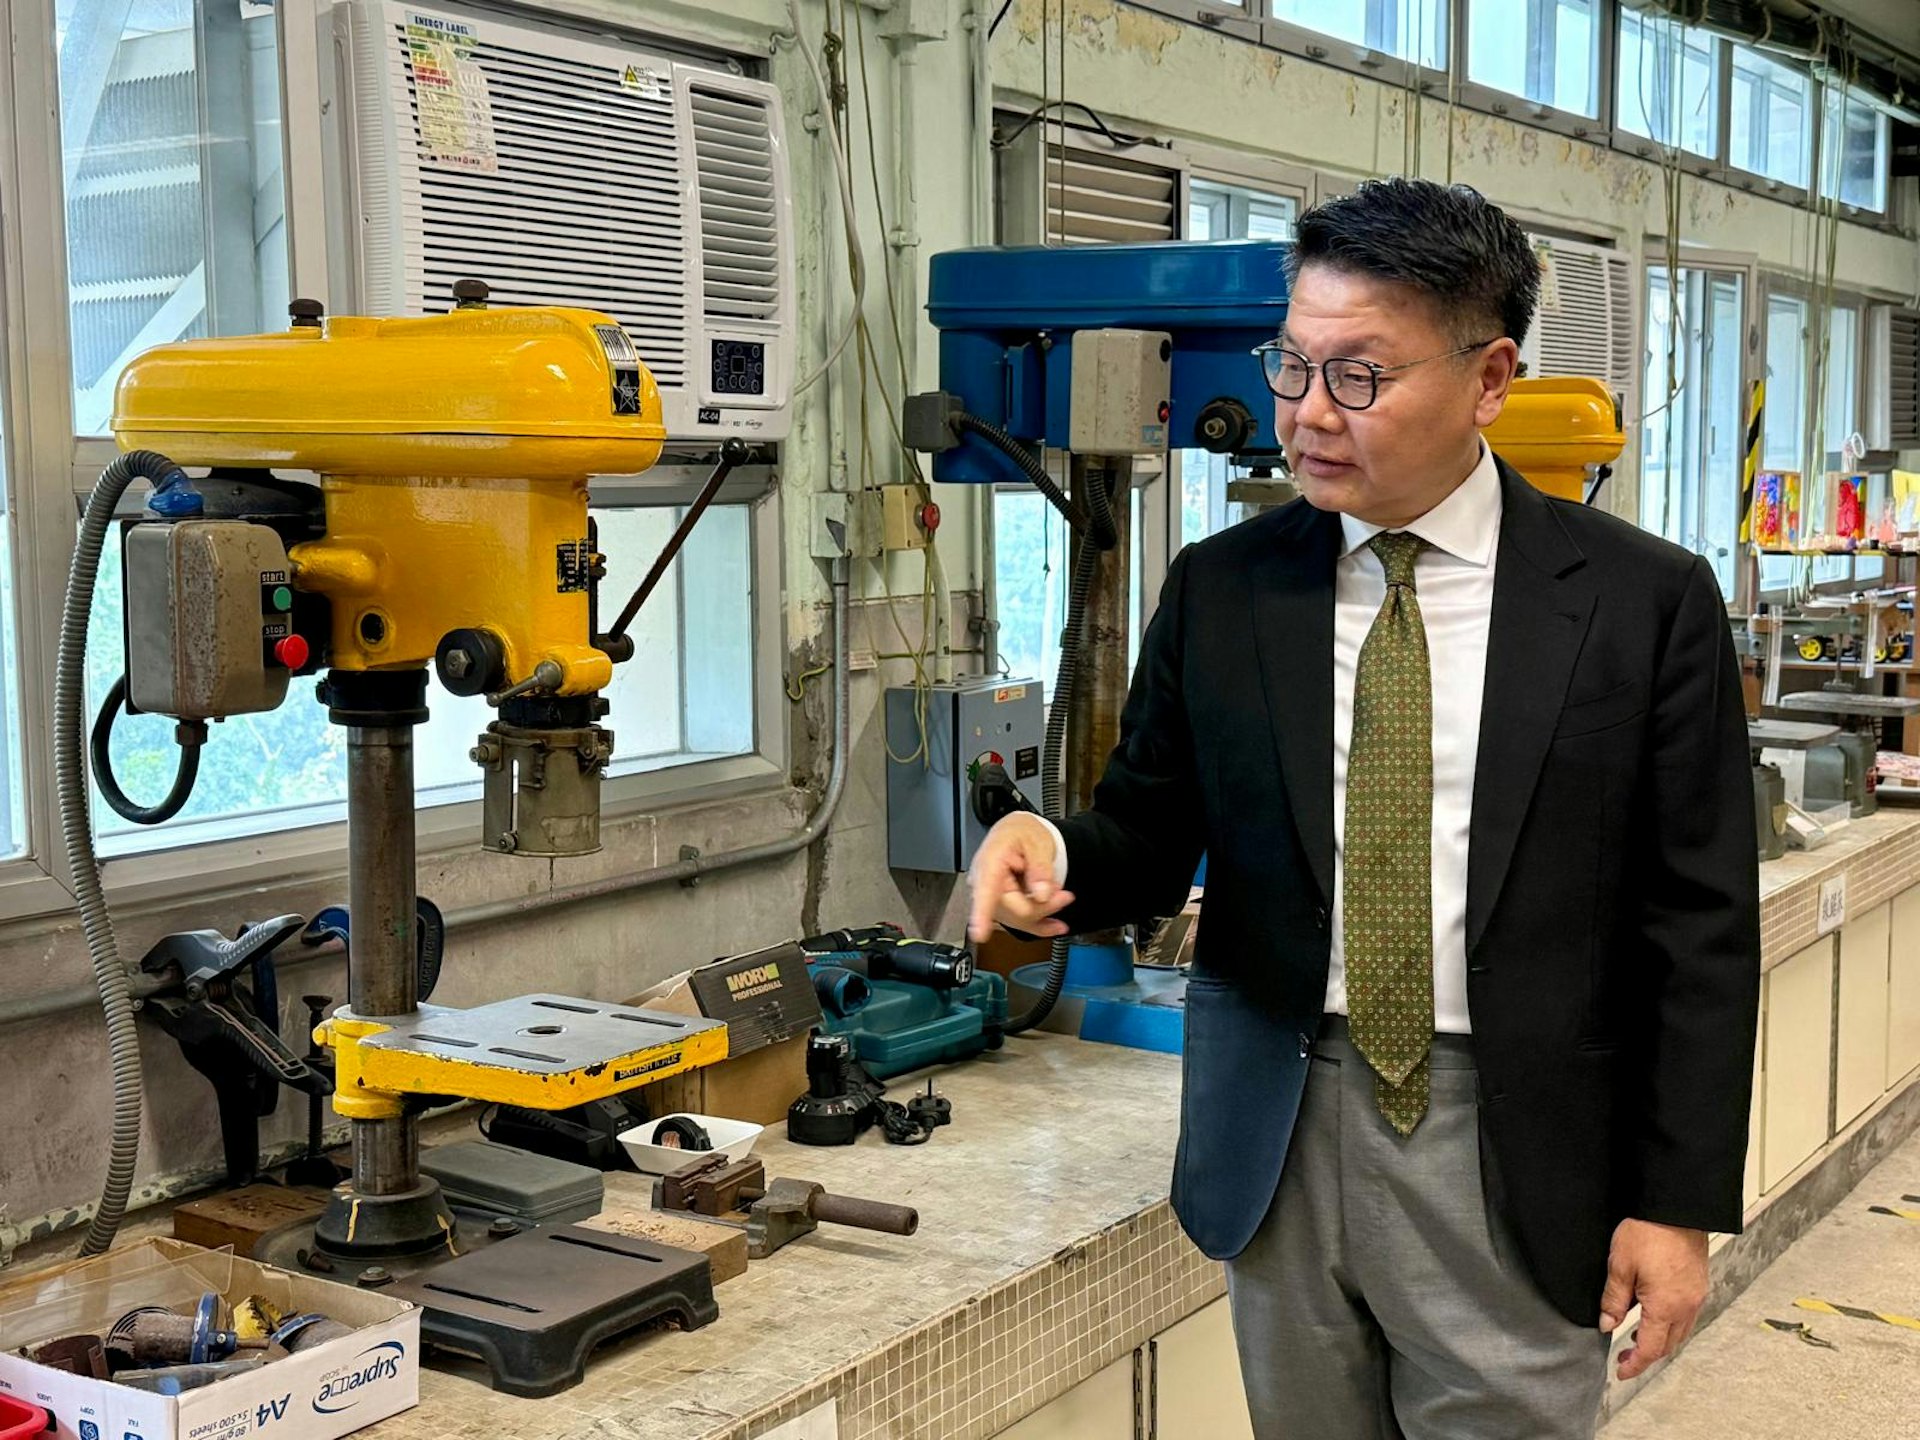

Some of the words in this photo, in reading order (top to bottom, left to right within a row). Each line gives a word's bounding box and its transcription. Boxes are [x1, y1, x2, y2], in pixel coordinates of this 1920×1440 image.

[414, 15, 443, 30] ENERGY
[446, 22, 470, 36] LABEL
[699, 411, 719, 421] AC-04
[261, 572, 285, 582] start
[265, 625, 286, 635] stop
[731, 979, 784, 1003] PROFESSIONAL
[619, 1061, 653, 1079] BRITISH
[255, 1392, 291, 1428] A4
[188, 1421, 218, 1439] sheets
